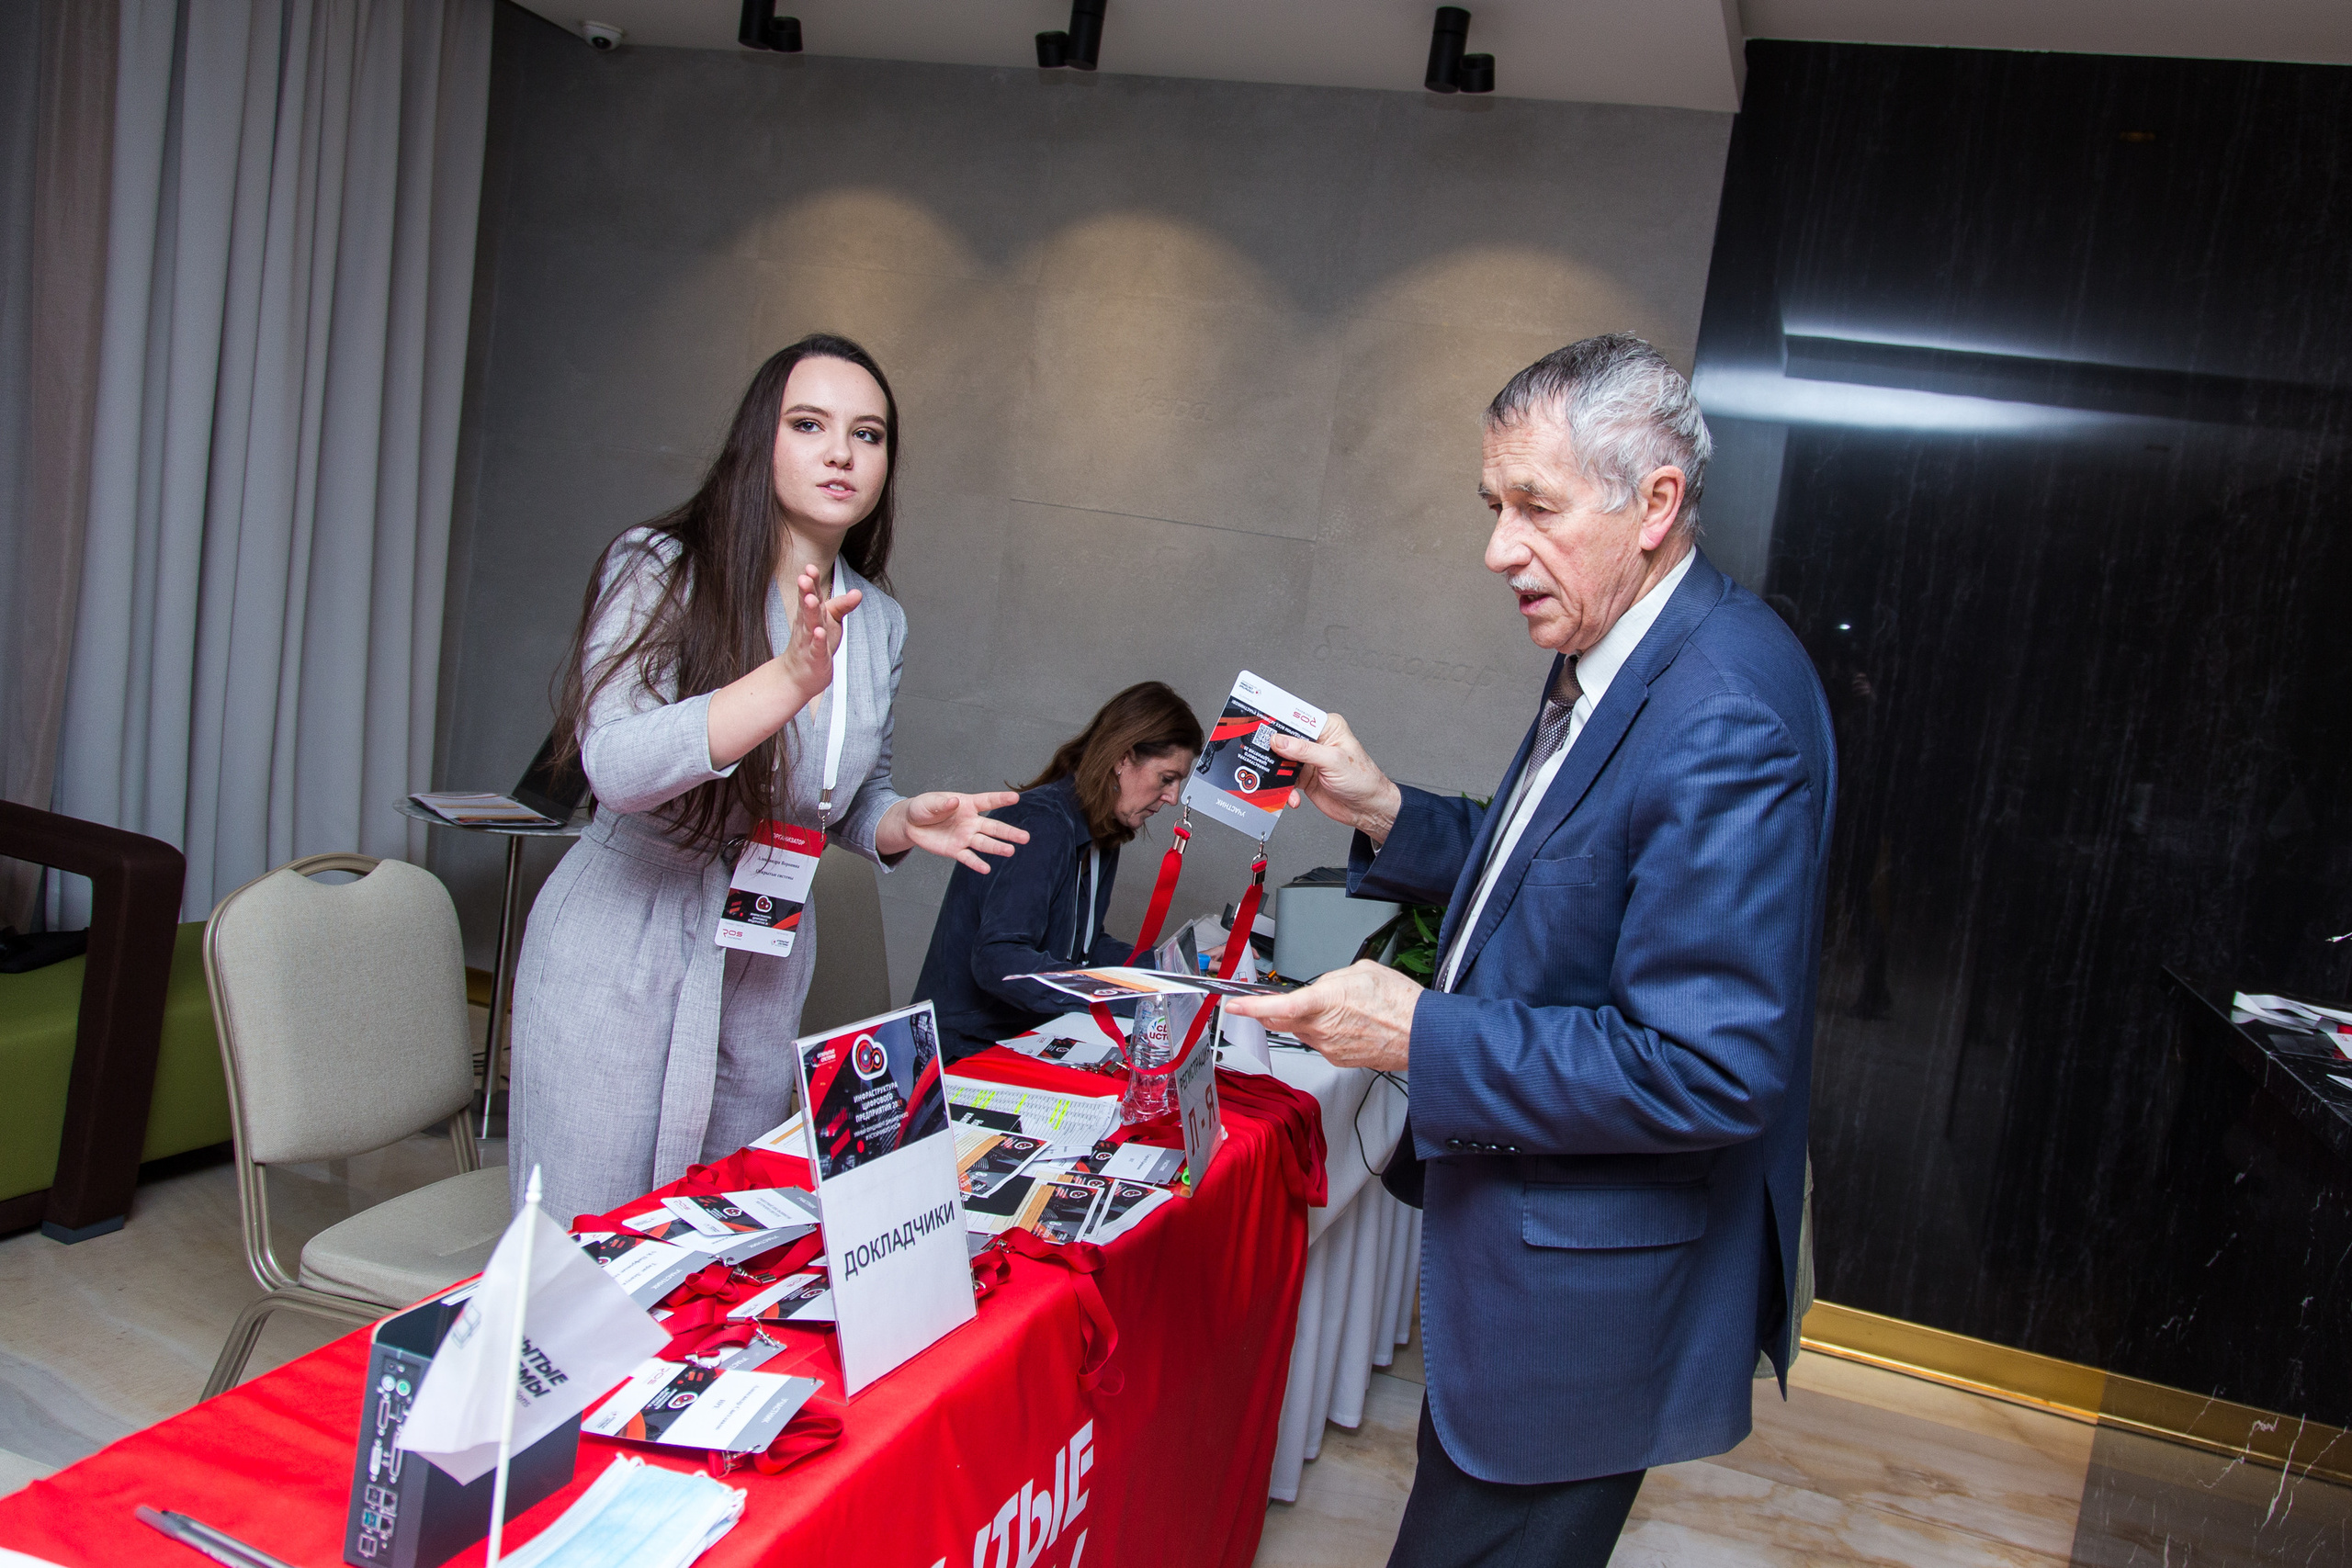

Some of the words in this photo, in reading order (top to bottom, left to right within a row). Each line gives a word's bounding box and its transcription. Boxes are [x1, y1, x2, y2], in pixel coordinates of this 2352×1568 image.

[1216, 798, 1246, 818] УЧАСТНИК
[854, 1081, 899, 1103] ИНФРАСТРУКТУРА
[862, 1093, 894, 1111] ЦИФРОВОГО
[855, 1103, 892, 1123] ПРЕДПРИЯТИЯ
[844, 1200, 956, 1281] ДОКЛАДЧИКИ
[521, 1336, 569, 1386] ЫТЫЕ
